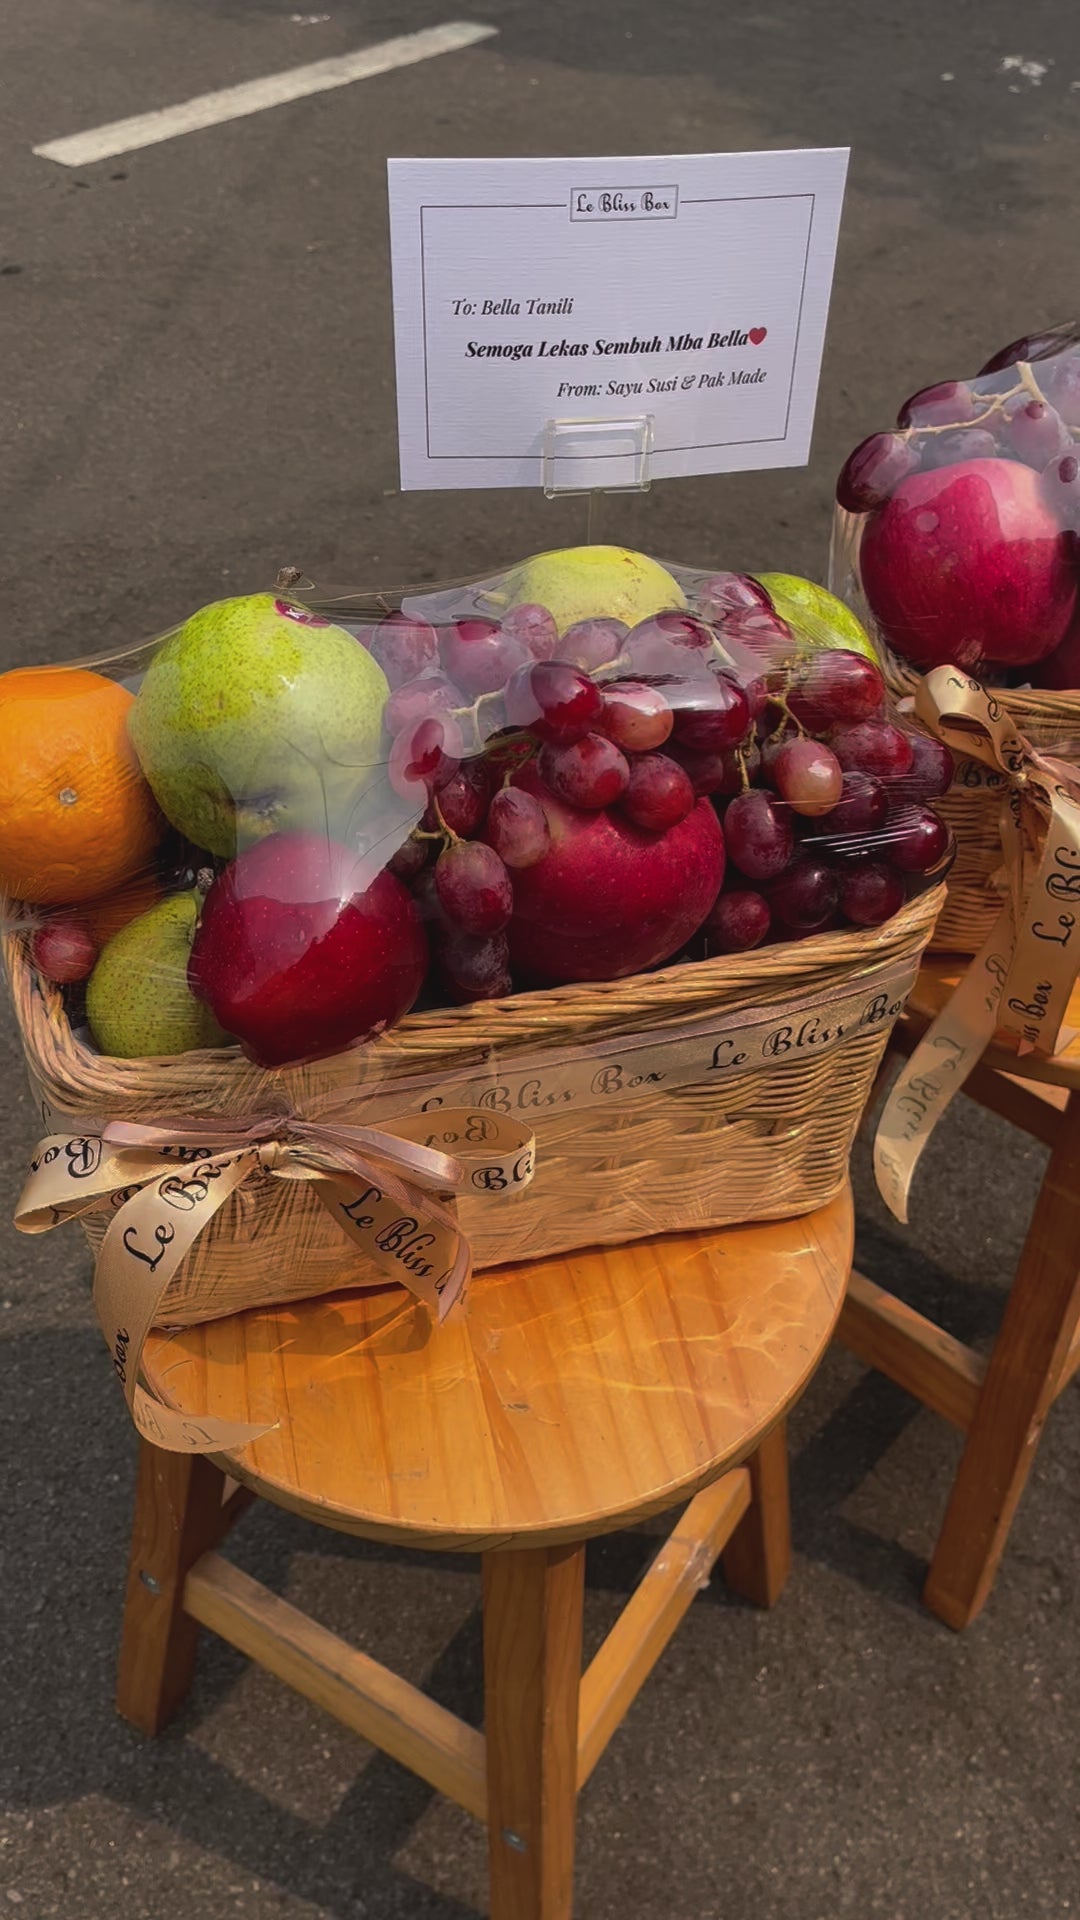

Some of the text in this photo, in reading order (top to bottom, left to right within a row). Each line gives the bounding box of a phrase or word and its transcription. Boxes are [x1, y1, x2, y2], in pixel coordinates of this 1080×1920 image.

[575, 191, 671, 213] Le Bliss Box
[451, 297, 575, 316] To: Bella Tanili
[464, 329, 750, 361] Semoga Lekas Sembuh Mba Bella
[556, 368, 768, 398] From: Sayu Susi & Pak Made
[1031, 912, 1076, 947] Le
[1008, 980, 1053, 1021] Box
[477, 1080, 577, 1114] Bliss
[590, 1064, 668, 1095] Box
[705, 1040, 749, 1071] Le
[762, 1018, 852, 1058] Bliss
[859, 993, 901, 1026] Bo
[471, 1151, 533, 1191] Bli
[122, 1221, 176, 1273] Le
[339, 1187, 436, 1277] Le Bliss
